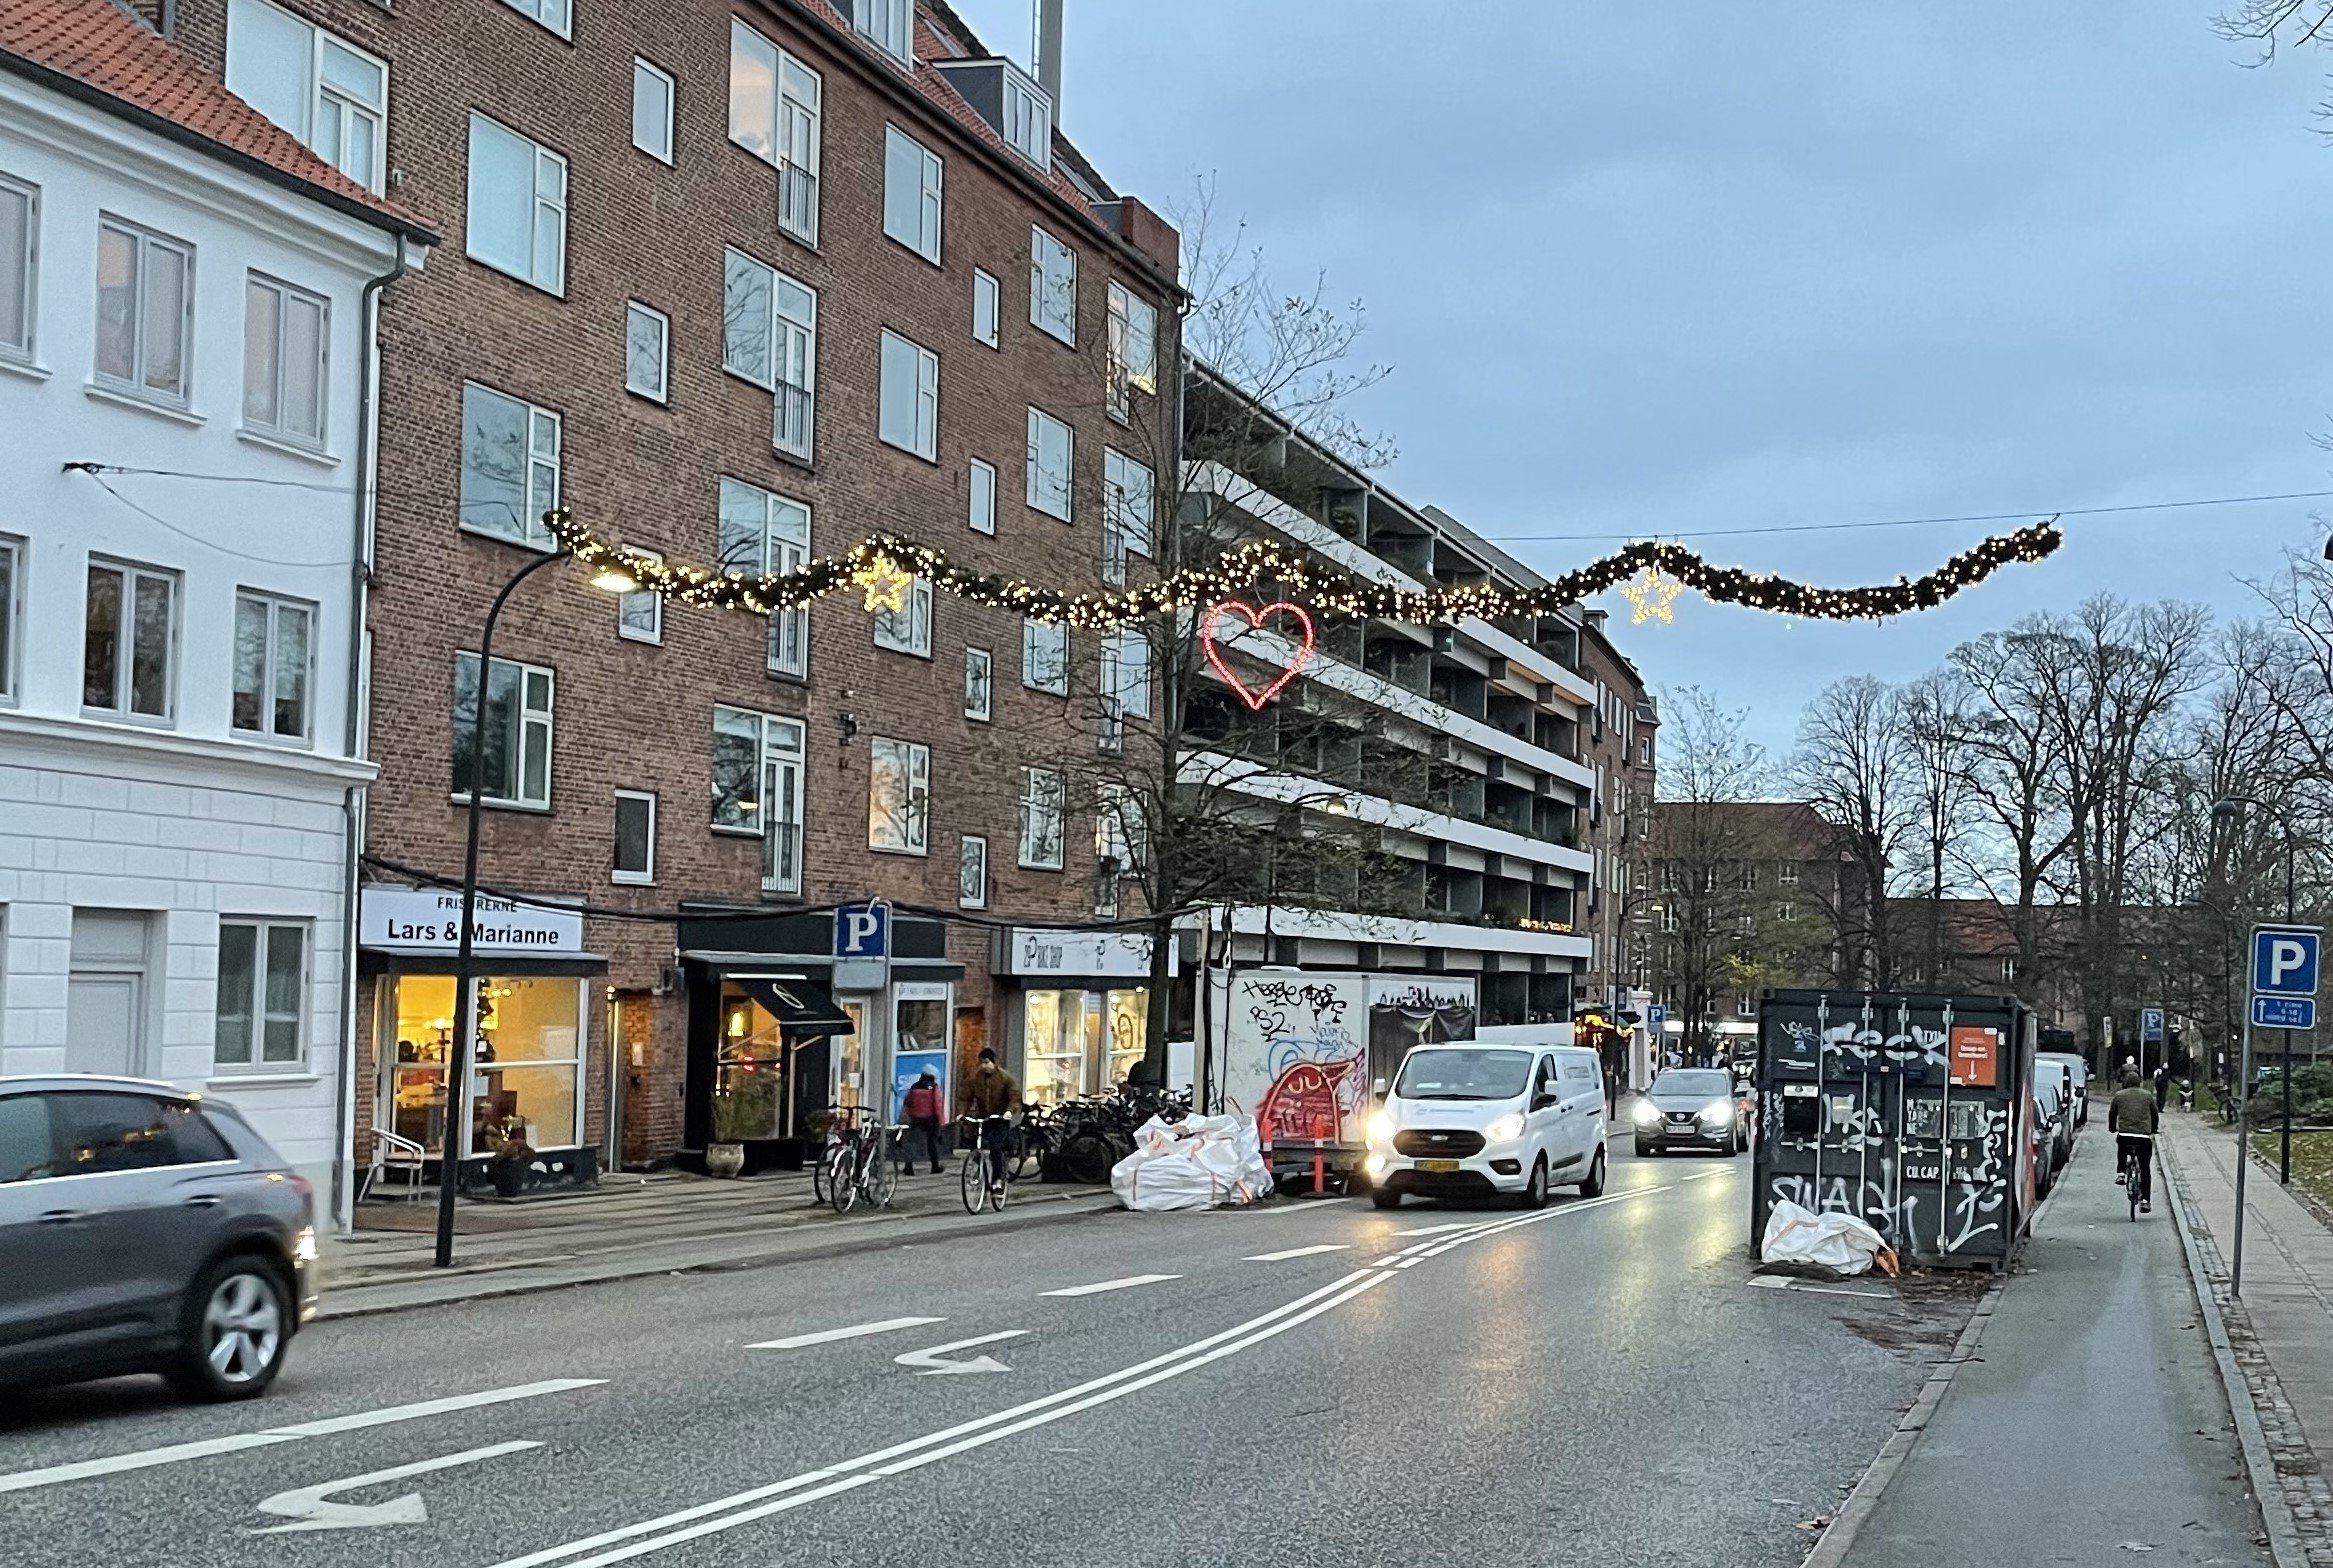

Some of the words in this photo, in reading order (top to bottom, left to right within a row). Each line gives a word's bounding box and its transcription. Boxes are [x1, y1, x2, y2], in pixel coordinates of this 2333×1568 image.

[437, 896, 517, 912] FRISRERNE
[388, 918, 436, 941] Lars
[444, 922, 458, 941] &
[470, 923, 559, 944] Marianne
[845, 912, 878, 952] P
[2271, 939, 2306, 985] P
[1650, 1008, 1661, 1022] P
